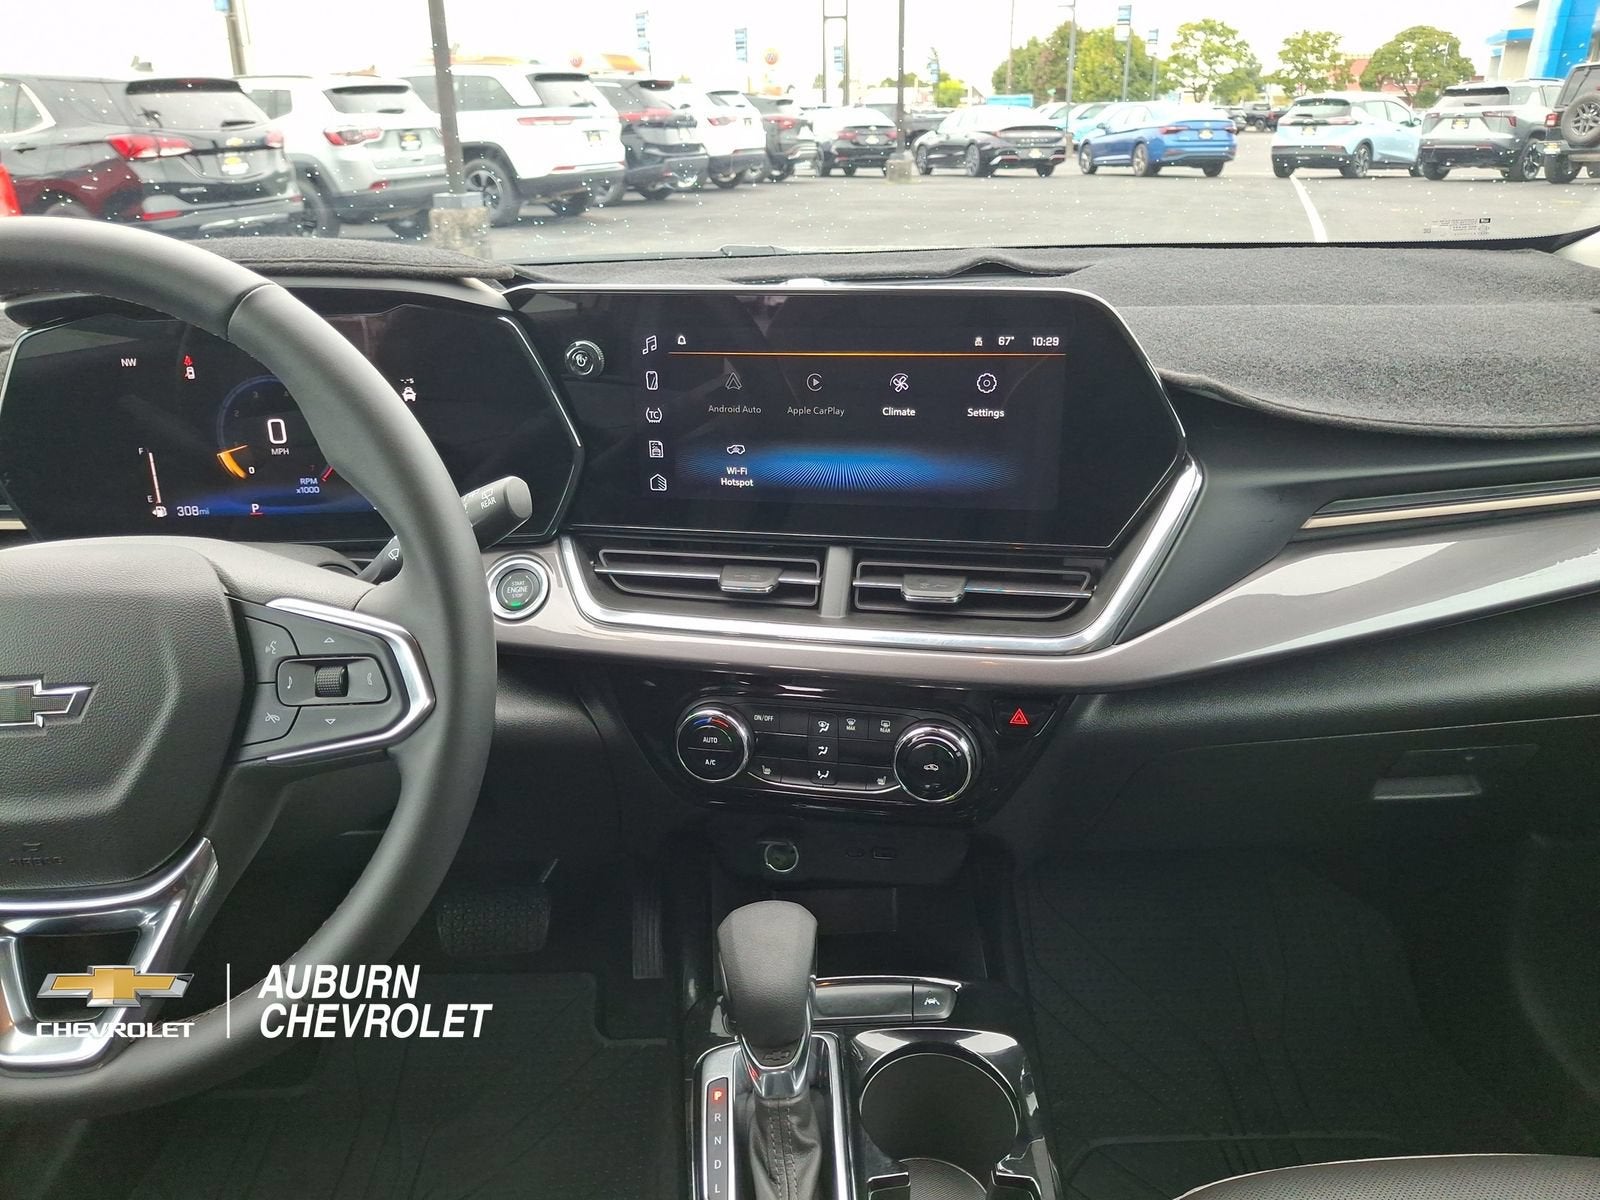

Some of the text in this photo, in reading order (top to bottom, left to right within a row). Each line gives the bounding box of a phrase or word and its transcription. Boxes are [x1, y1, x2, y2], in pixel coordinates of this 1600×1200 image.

[998, 336, 1060, 347] 67° 10:29
[120, 358, 137, 367] NW
[708, 405, 762, 414] Android Auto
[787, 406, 845, 417] Apple CarPlay
[882, 407, 916, 416] Climate
[967, 408, 1005, 419] Settings
[267, 418, 288, 445] 0
[138, 447, 144, 455] F
[271, 448, 290, 456] MPH
[248, 466, 255, 475] 0
[726, 467, 748, 476] Wi-Fi
[720, 478, 754, 488] Hotspot
[296, 486, 320, 494] x1000
[147, 495, 153, 503] E
[480, 496, 497, 510] REAR
[251, 503, 260, 513] P
[507, 585, 529, 594] ENGINE
[753, 714, 774, 722] ON/OFF
[703, 736, 718, 744] AUTO
[714, 1090, 722, 1101] P
[714, 1113, 722, 1122] R
[714, 1136, 722, 1145] N
[714, 1160, 722, 1169] D
[714, 1184, 721, 1193] L
